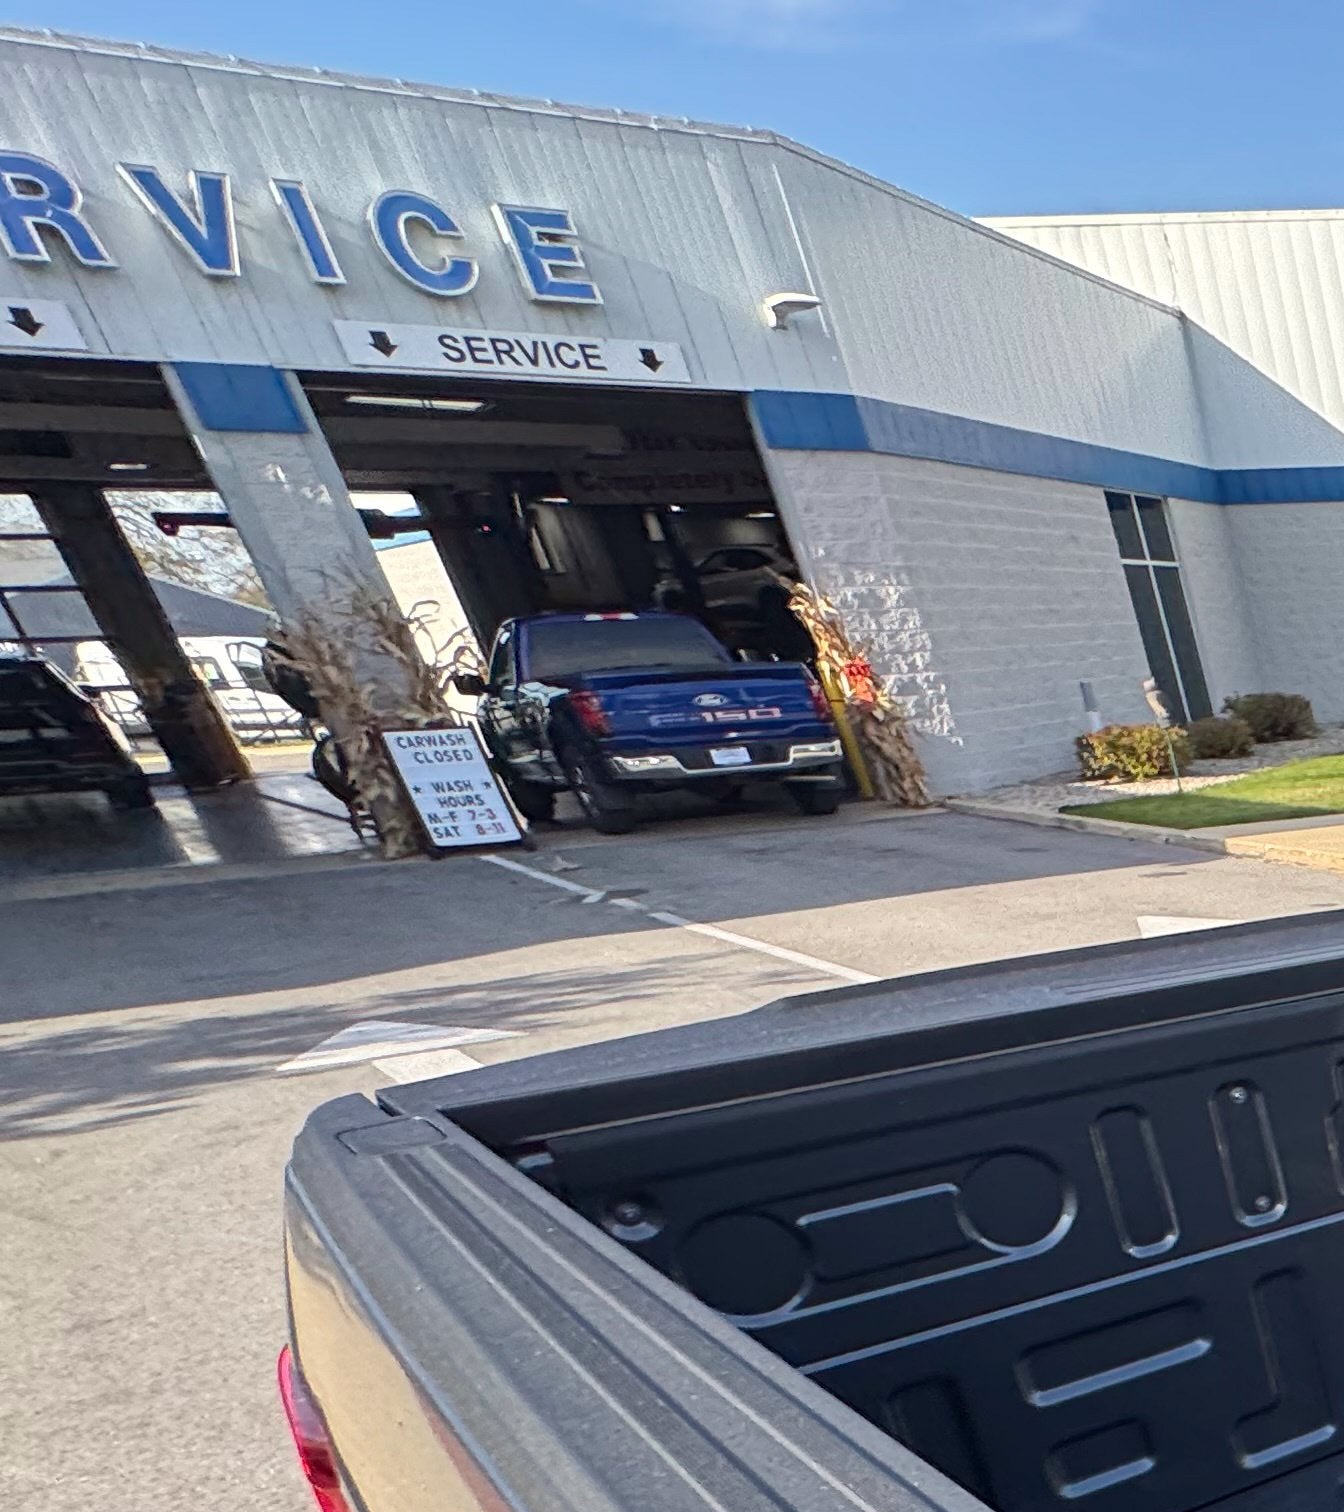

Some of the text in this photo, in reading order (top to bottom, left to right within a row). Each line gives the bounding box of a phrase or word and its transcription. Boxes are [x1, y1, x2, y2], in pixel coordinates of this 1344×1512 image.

[0, 150, 603, 305] RVICE
[438, 334, 608, 371] SERVICE
[396, 733, 466, 749] CARWASH
[413, 749, 474, 764] CLOSED
[431, 780, 474, 793] WASH
[438, 794, 486, 808] HOURS
[427, 808, 497, 824] M-F 7-3
[432, 826, 461, 839] SAT
